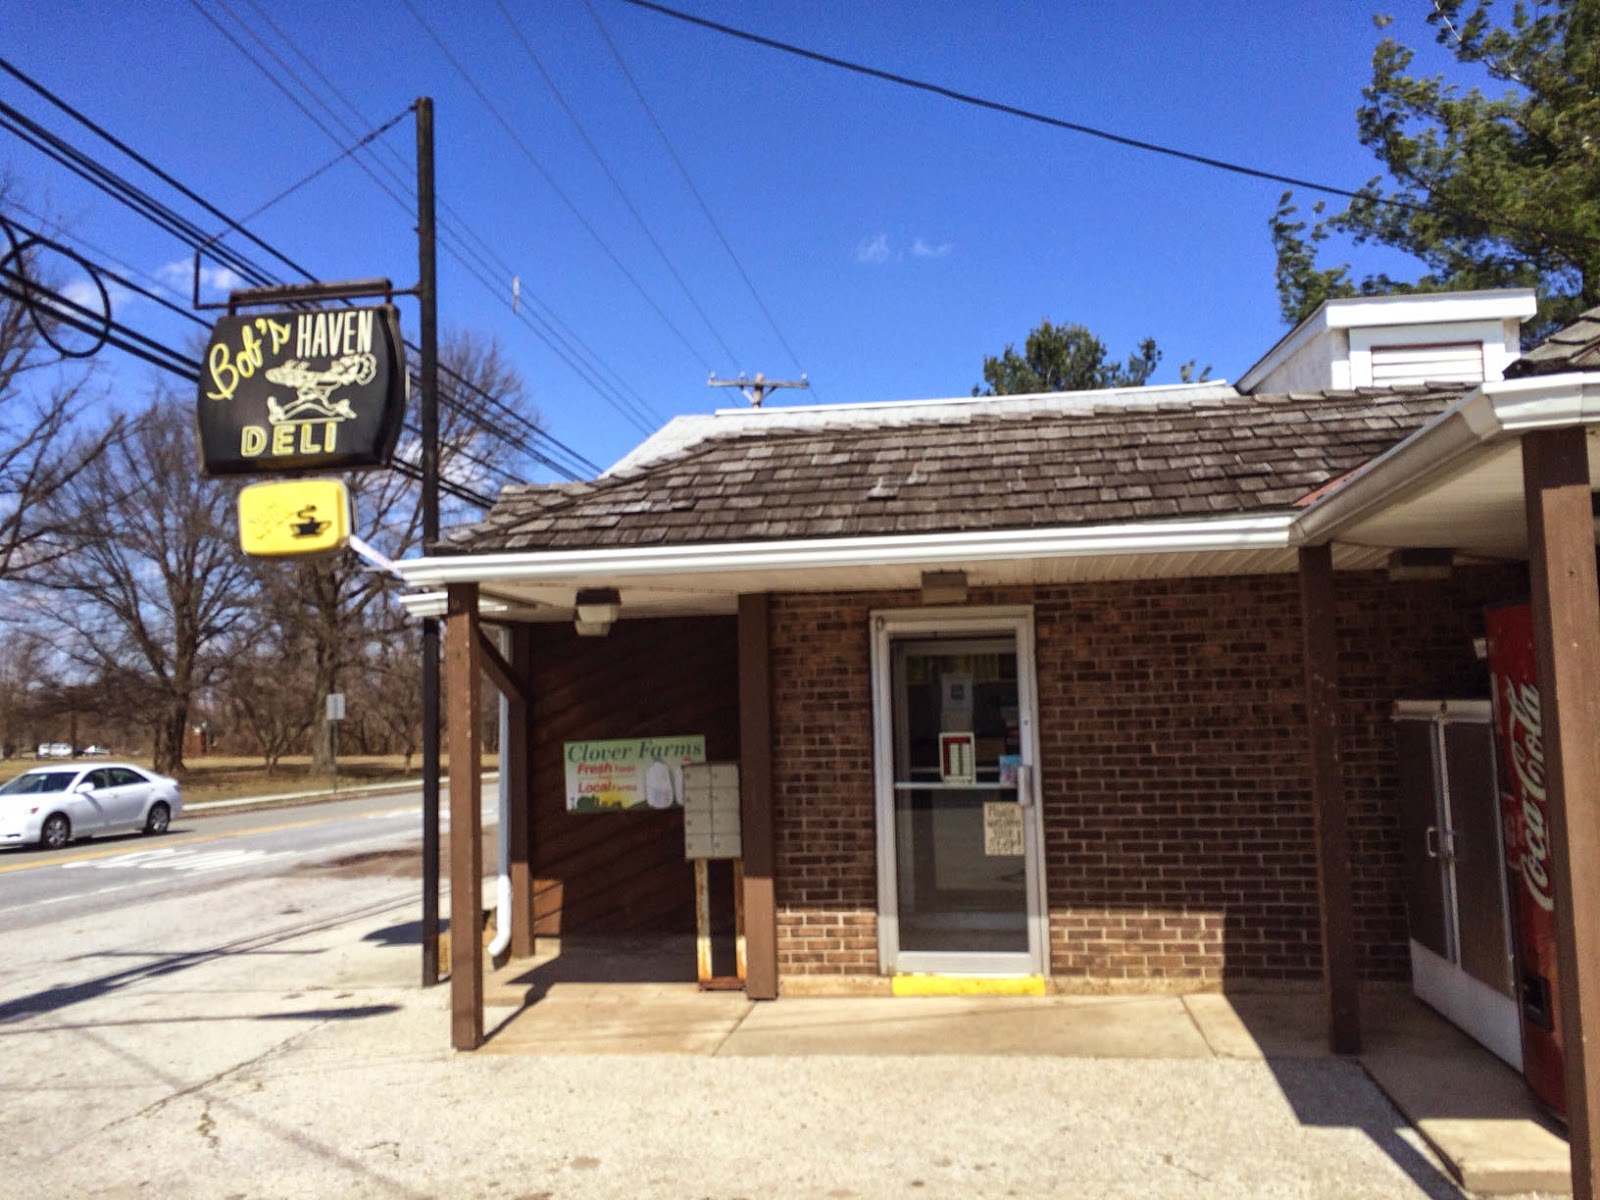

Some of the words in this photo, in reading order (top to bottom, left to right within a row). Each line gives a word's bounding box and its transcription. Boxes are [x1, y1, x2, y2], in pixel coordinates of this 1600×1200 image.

[207, 318, 291, 400] Bob's
[296, 310, 374, 358] HAVEN
[240, 421, 338, 457] DELI
[568, 743, 632, 763] Clover
[639, 740, 701, 759] Farms
[577, 763, 613, 776] Fresh
[578, 782, 613, 794] Local
